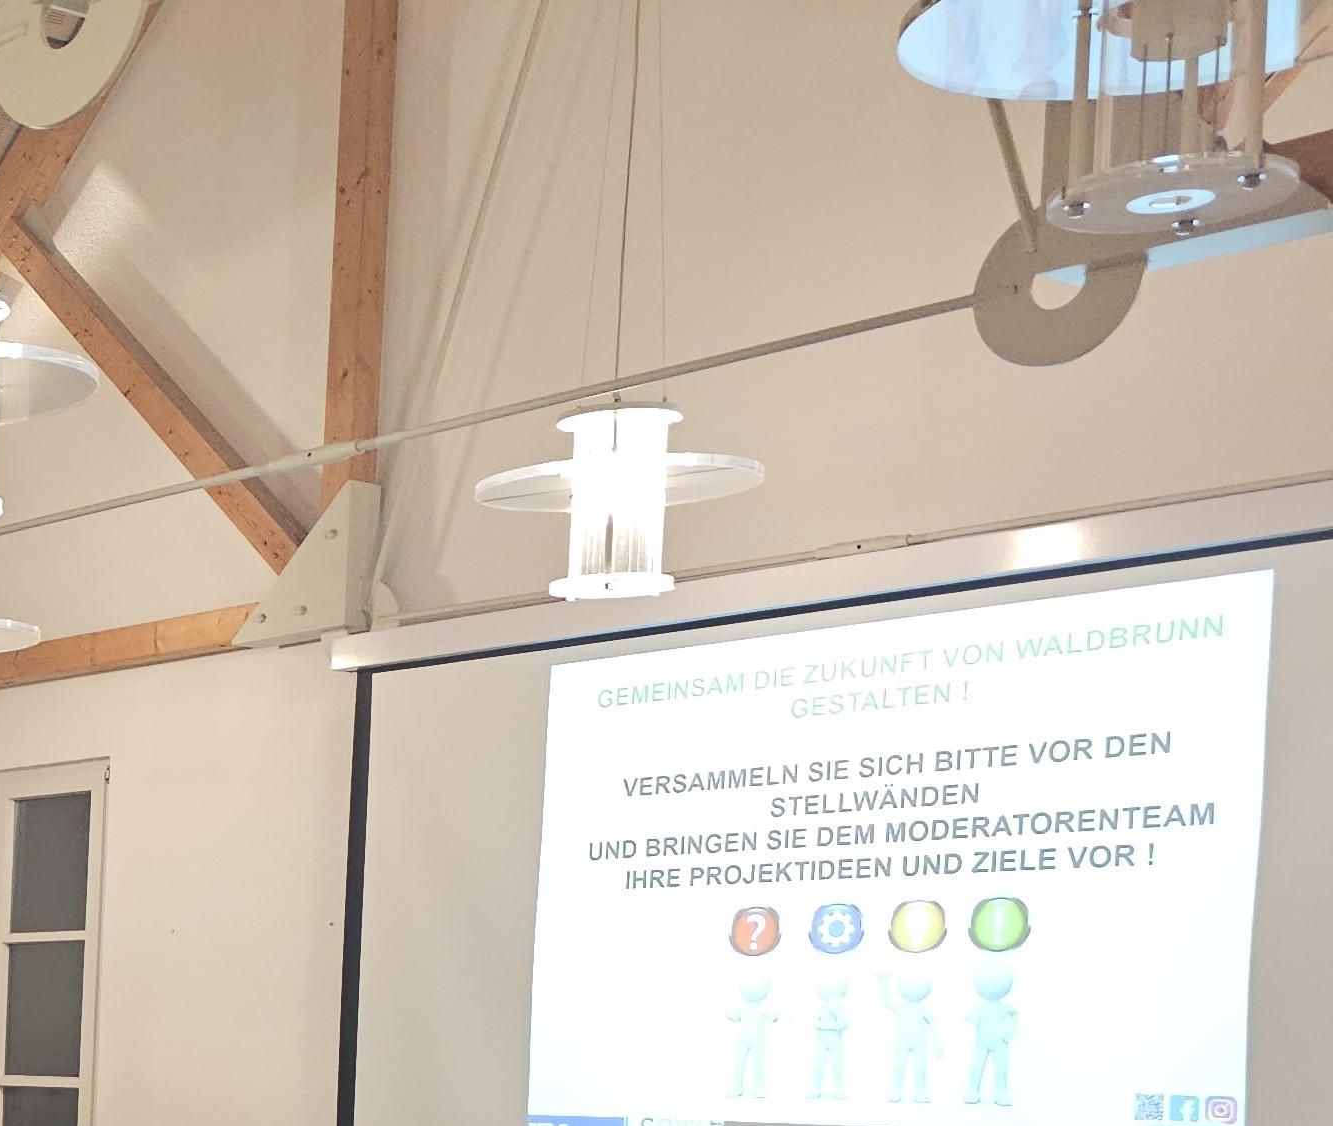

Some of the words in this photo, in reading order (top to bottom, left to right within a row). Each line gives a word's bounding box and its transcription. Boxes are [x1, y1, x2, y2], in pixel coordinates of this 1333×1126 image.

[597, 672, 744, 708] GEMEINSAM
[754, 666, 796, 690] DIE
[803, 650, 933, 684] ZUKUNFT
[943, 641, 1004, 667] VON
[1016, 614, 1224, 659] WALDBRUNN
[790, 682, 951, 719] GESTALTEN
[961, 680, 970, 701] !
[623, 763, 799, 797] VERSAMMELN
[808, 758, 850, 783] SIE
[858, 752, 924, 778] SICH
[934, 744, 1019, 772] BITTE
[1028, 738, 1094, 764] VOR
[1104, 731, 1172, 759] DEN
[770, 782, 980, 818] STELLWÄNDEN
[589, 838, 638, 861] UND
[645, 831, 758, 858] BRINGEN
[766, 828, 808, 851] SIE
[816, 822, 876, 847] DEM
[884, 802, 1216, 843] MODERATORENTEAM
[625, 868, 682, 890] IHRE
[689, 856, 893, 887] PROJEKTIDEEN
[901, 852, 964, 877] UND
[971, 847, 1058, 874] ZIELE
[1067, 843, 1136, 869] VOR
[1147, 843, 1156, 866] !
